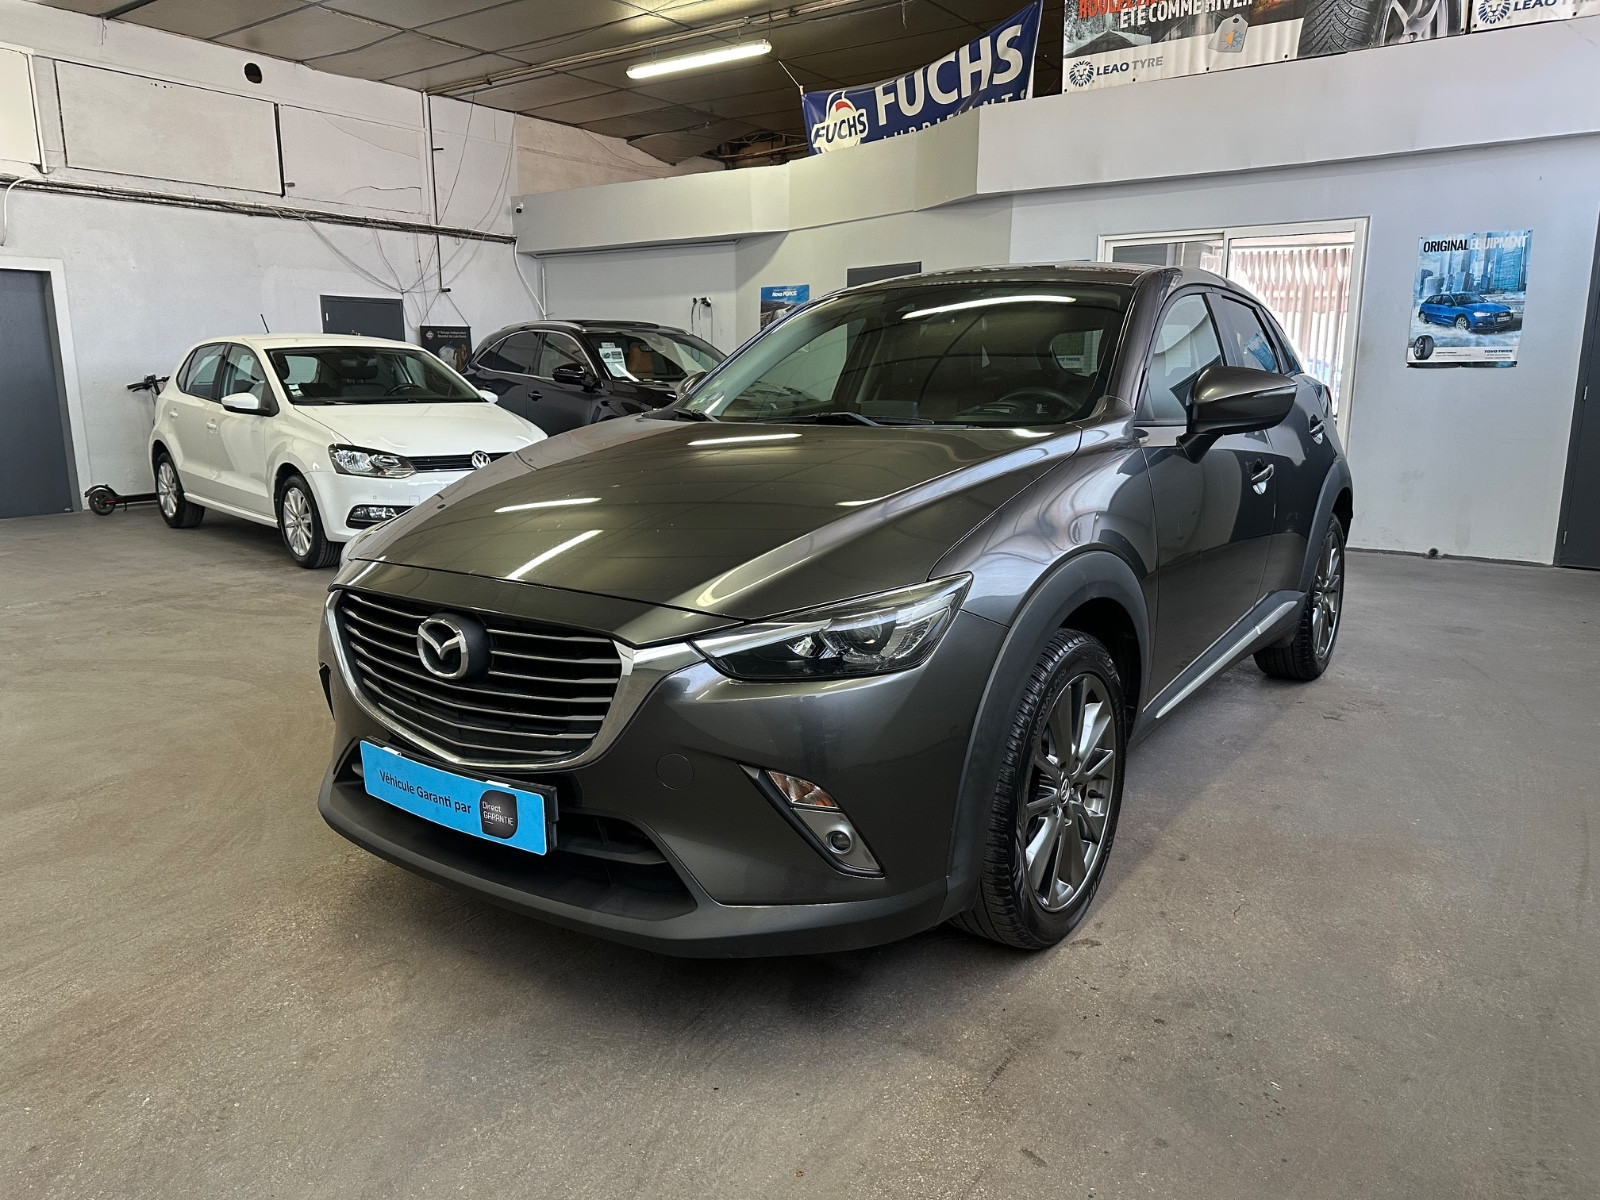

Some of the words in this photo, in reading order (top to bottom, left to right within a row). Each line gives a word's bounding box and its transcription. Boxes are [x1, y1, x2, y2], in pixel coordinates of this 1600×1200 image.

[1148, 0, 1202, 23] COMME
[874, 24, 1024, 126] FUCHS
[1096, 62, 1130, 76] LEAO
[1131, 56, 1164, 70] TYRE
[813, 112, 868, 144] FUCHS
[1423, 239, 1469, 253] ORIGINAL
[379, 769, 415, 795] Véhicule
[416, 785, 452, 809] Garanti
[454, 800, 472, 814] par
[482, 801, 502, 813] Direct
[483, 810, 514, 826] GARANTIE
